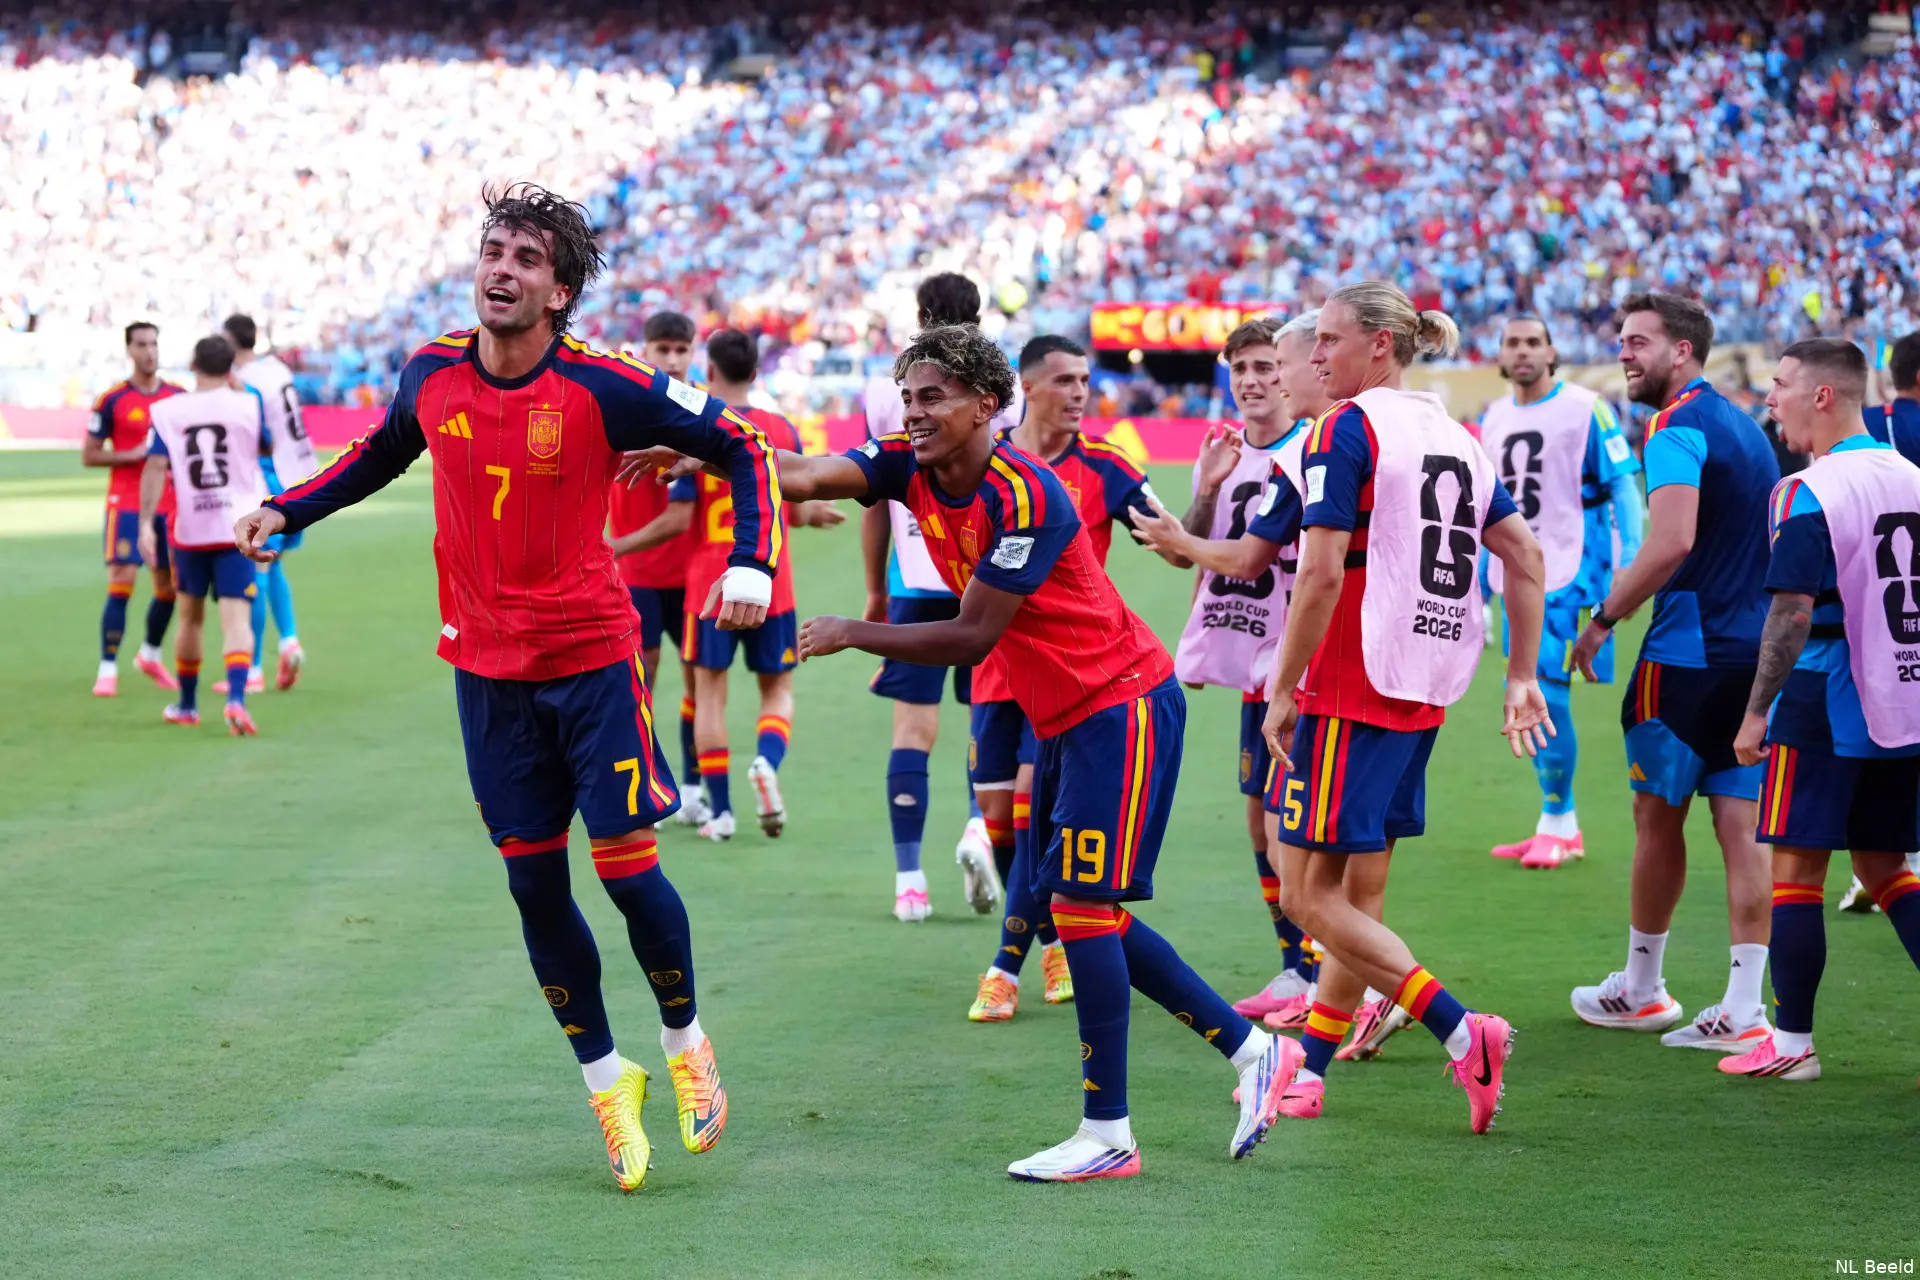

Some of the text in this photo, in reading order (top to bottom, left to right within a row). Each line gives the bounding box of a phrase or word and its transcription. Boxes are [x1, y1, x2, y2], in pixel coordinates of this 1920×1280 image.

[486, 464, 510, 520] 7
[1433, 567, 1456, 586] FIFA
[1203, 600, 1270, 618] WORLD CUP
[1417, 599, 1466, 619] WORLD CUP
[1202, 613, 1267, 638] 2026
[1412, 614, 1462, 642] 2026
[1893, 650, 1920, 662] WORL
[1897, 664, 1920, 682] 20
[613, 757, 641, 816] 7
[1283, 778, 1305, 831] 5
[1062, 827, 1106, 883] 19
